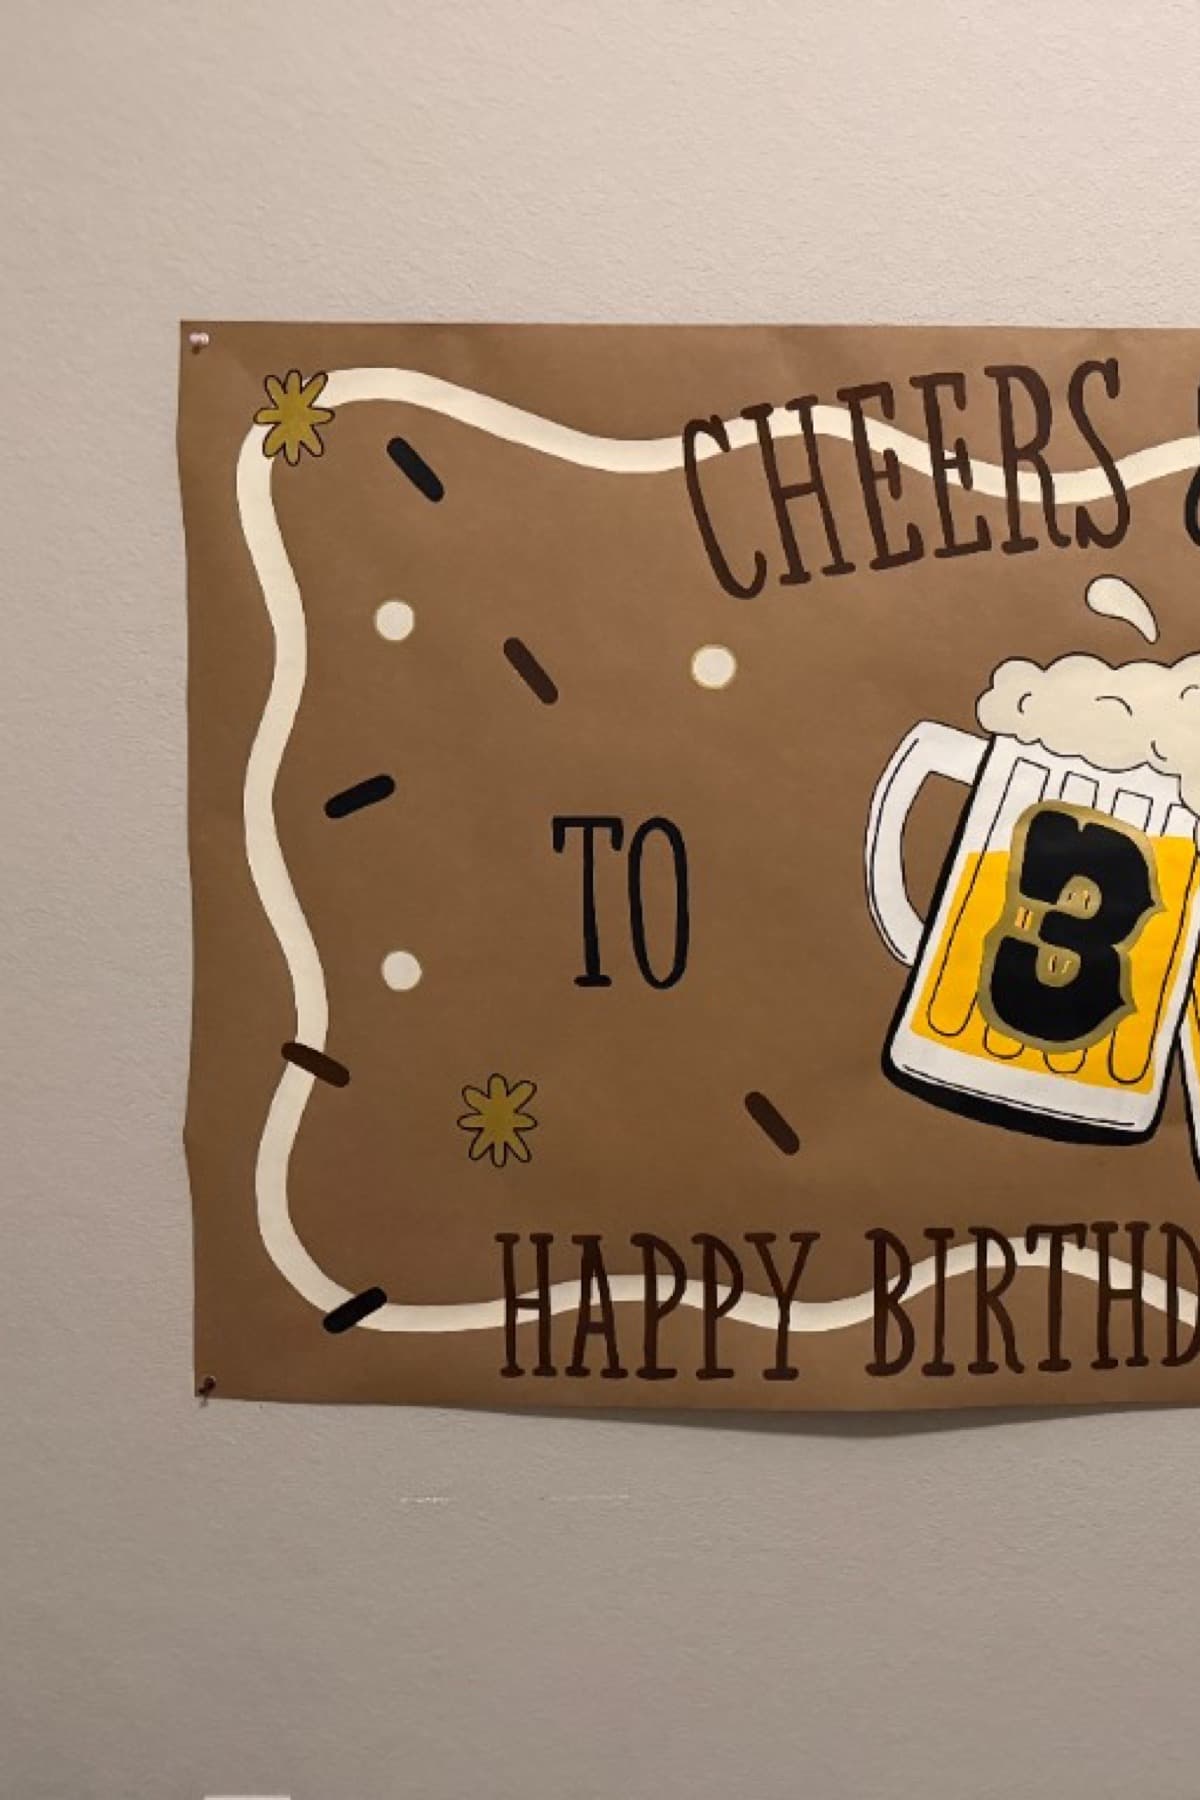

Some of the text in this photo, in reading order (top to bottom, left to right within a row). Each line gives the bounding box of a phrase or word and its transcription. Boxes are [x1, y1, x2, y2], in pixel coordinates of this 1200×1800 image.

[683, 357, 1131, 600] CHEERS
[552, 815, 690, 989] TO
[494, 1232, 821, 1381] HAPPY
